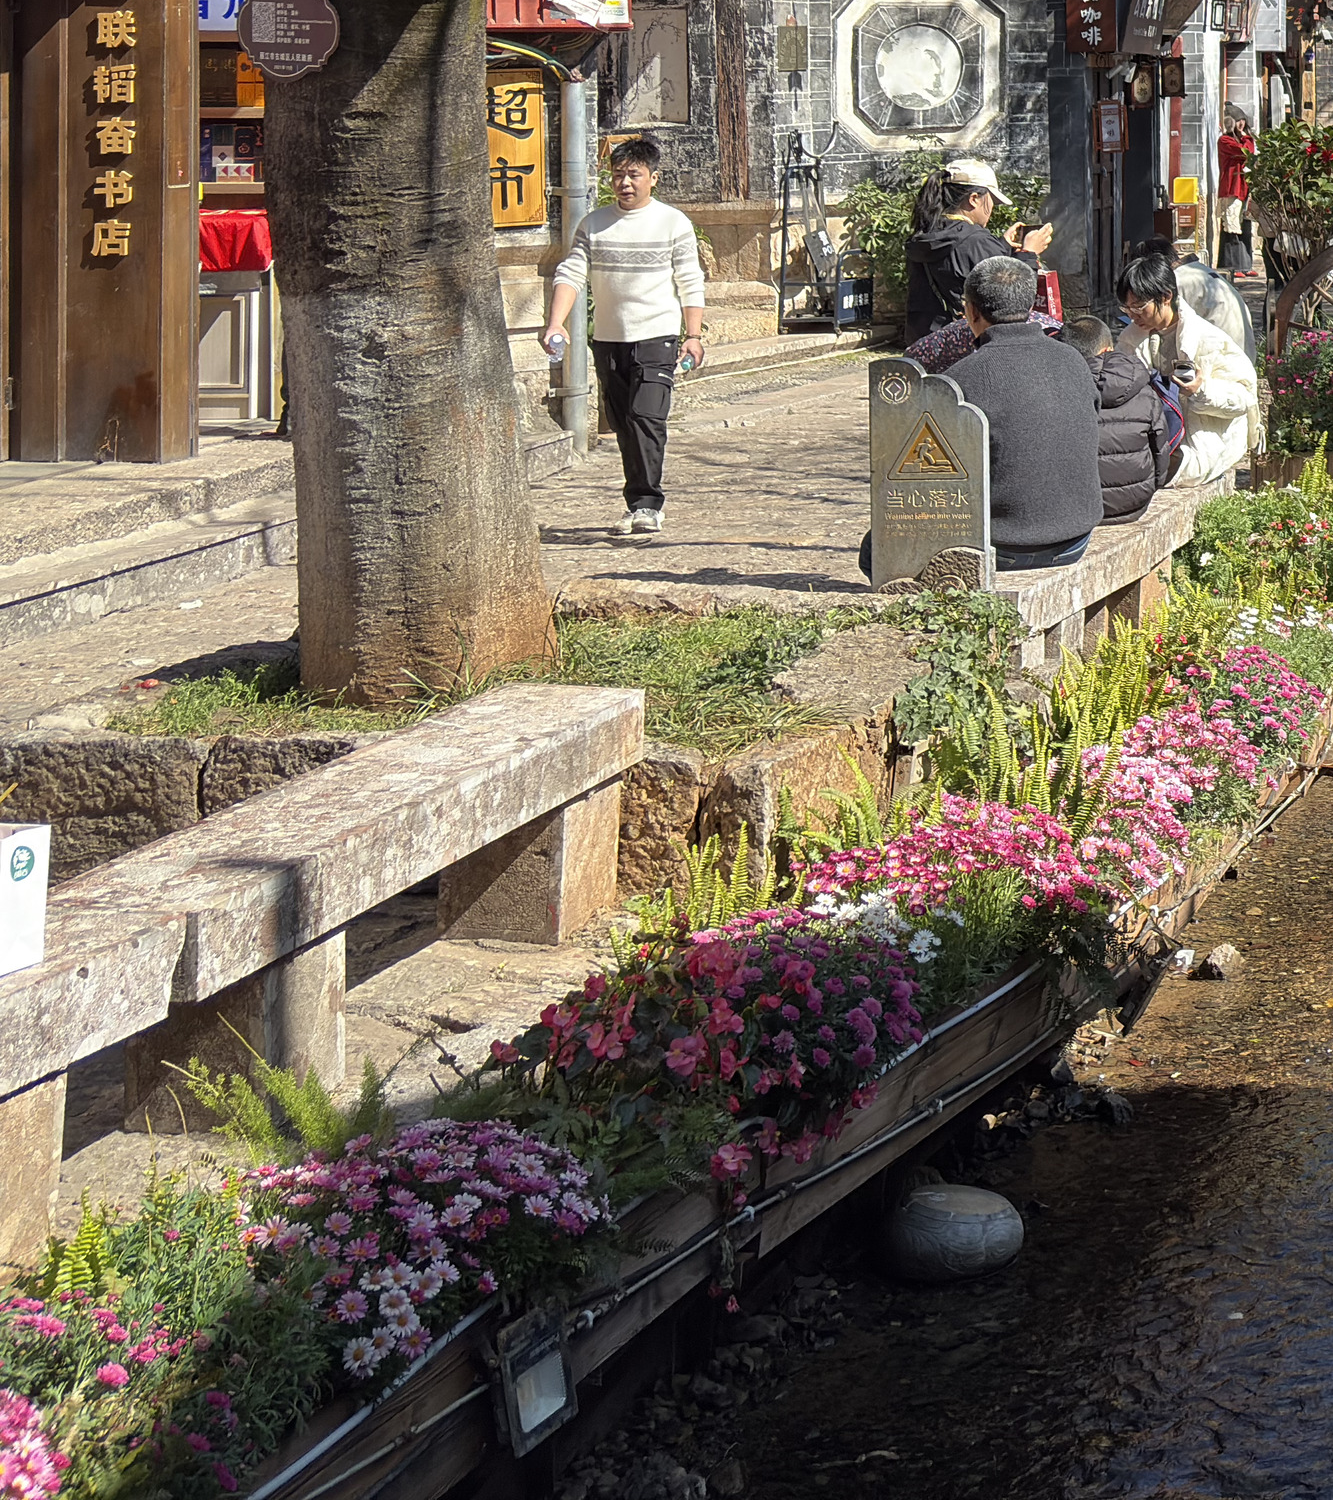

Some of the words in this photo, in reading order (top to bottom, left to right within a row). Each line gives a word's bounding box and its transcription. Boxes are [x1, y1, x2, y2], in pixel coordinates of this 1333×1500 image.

[486, 86, 535, 211] 超市
[886, 488, 970, 508] 当心落水
